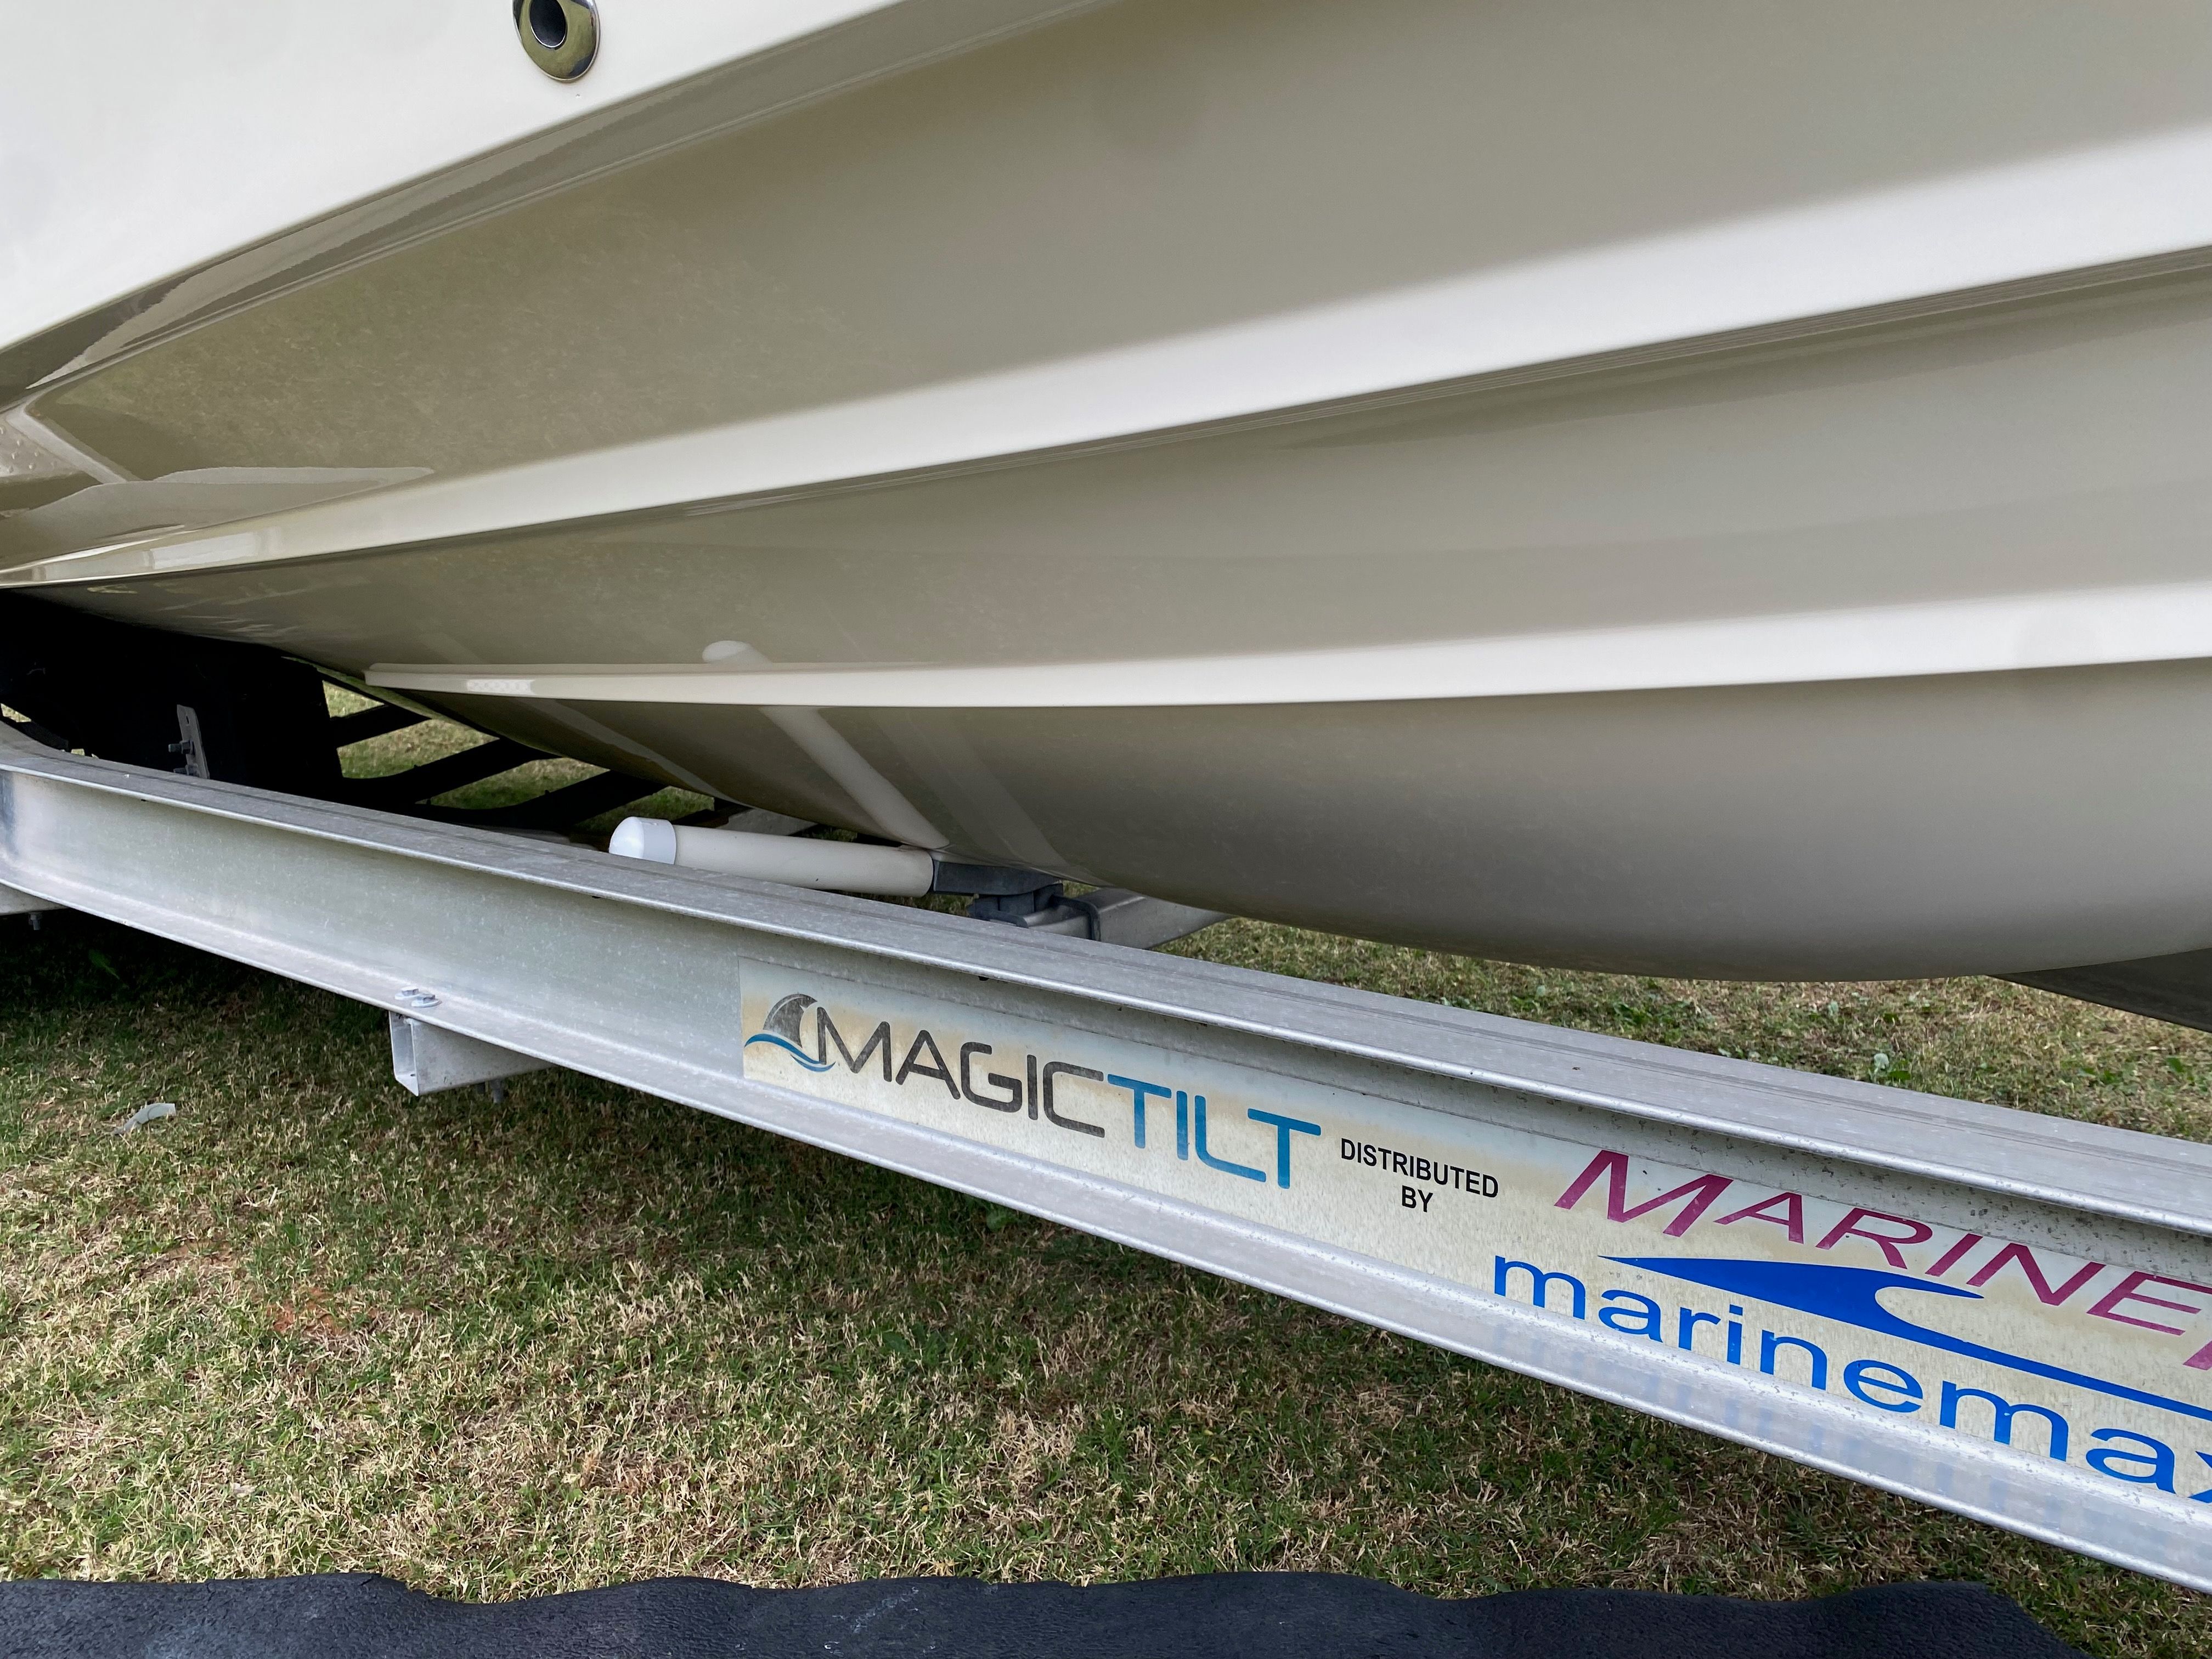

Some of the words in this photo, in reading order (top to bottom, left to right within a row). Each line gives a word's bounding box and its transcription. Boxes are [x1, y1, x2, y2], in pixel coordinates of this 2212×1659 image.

[816, 1006, 1322, 1189] MAGICTILT
[1340, 1137, 1499, 1199] DISTRIBUTED
[1401, 1184, 1434, 1213] BY
[1554, 1149, 2212, 1370] MARINE
